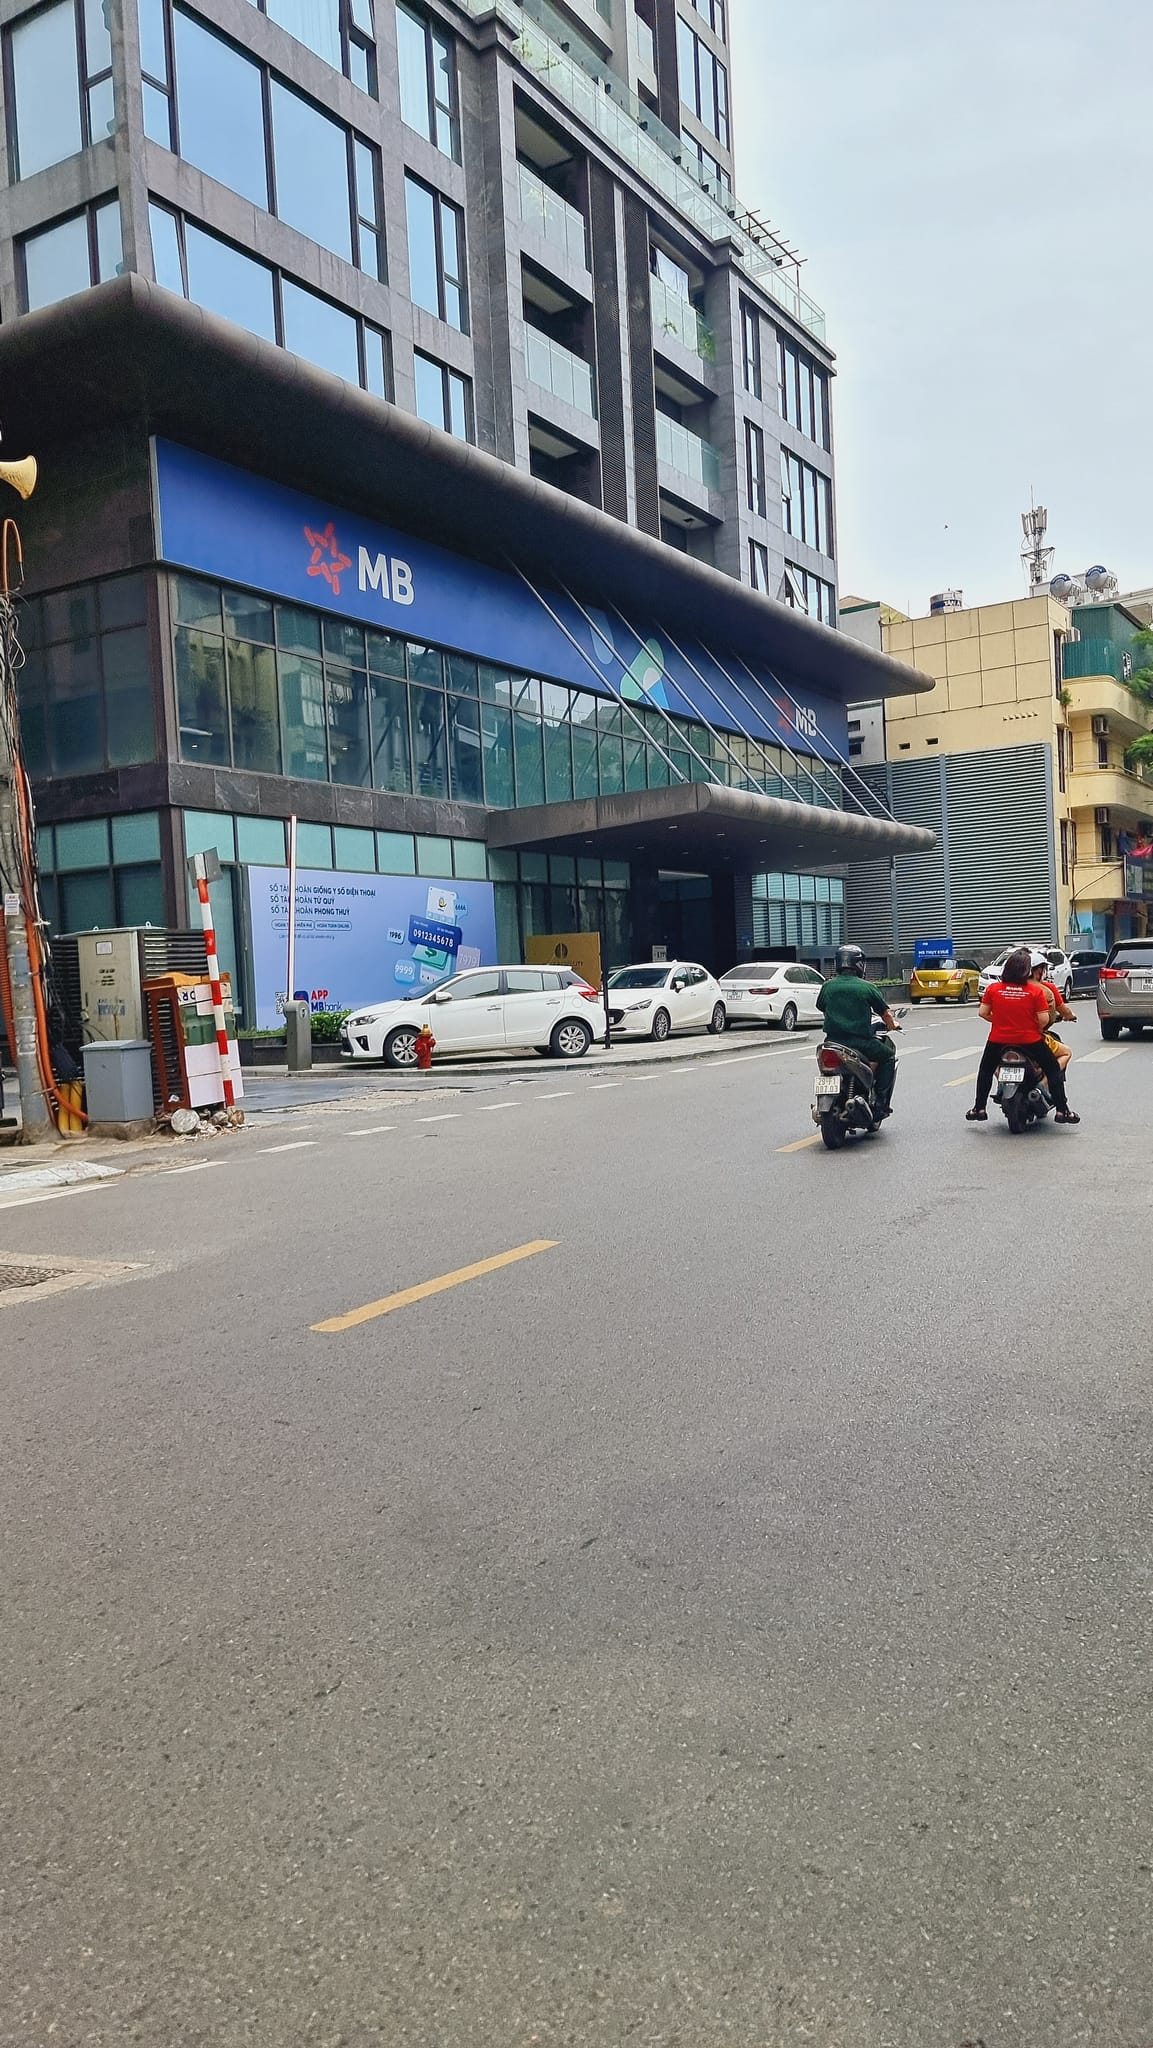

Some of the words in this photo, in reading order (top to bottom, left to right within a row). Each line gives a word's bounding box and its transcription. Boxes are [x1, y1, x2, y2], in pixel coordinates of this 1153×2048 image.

[358, 545, 415, 606] MB
[795, 707, 817, 737] MB
[314, 907, 335, 915] PHONG
[389, 931, 402, 940] 1996
[413, 929, 454, 947] 0912345678
[394, 964, 414, 976] 9999
[311, 989, 328, 1000] APP
